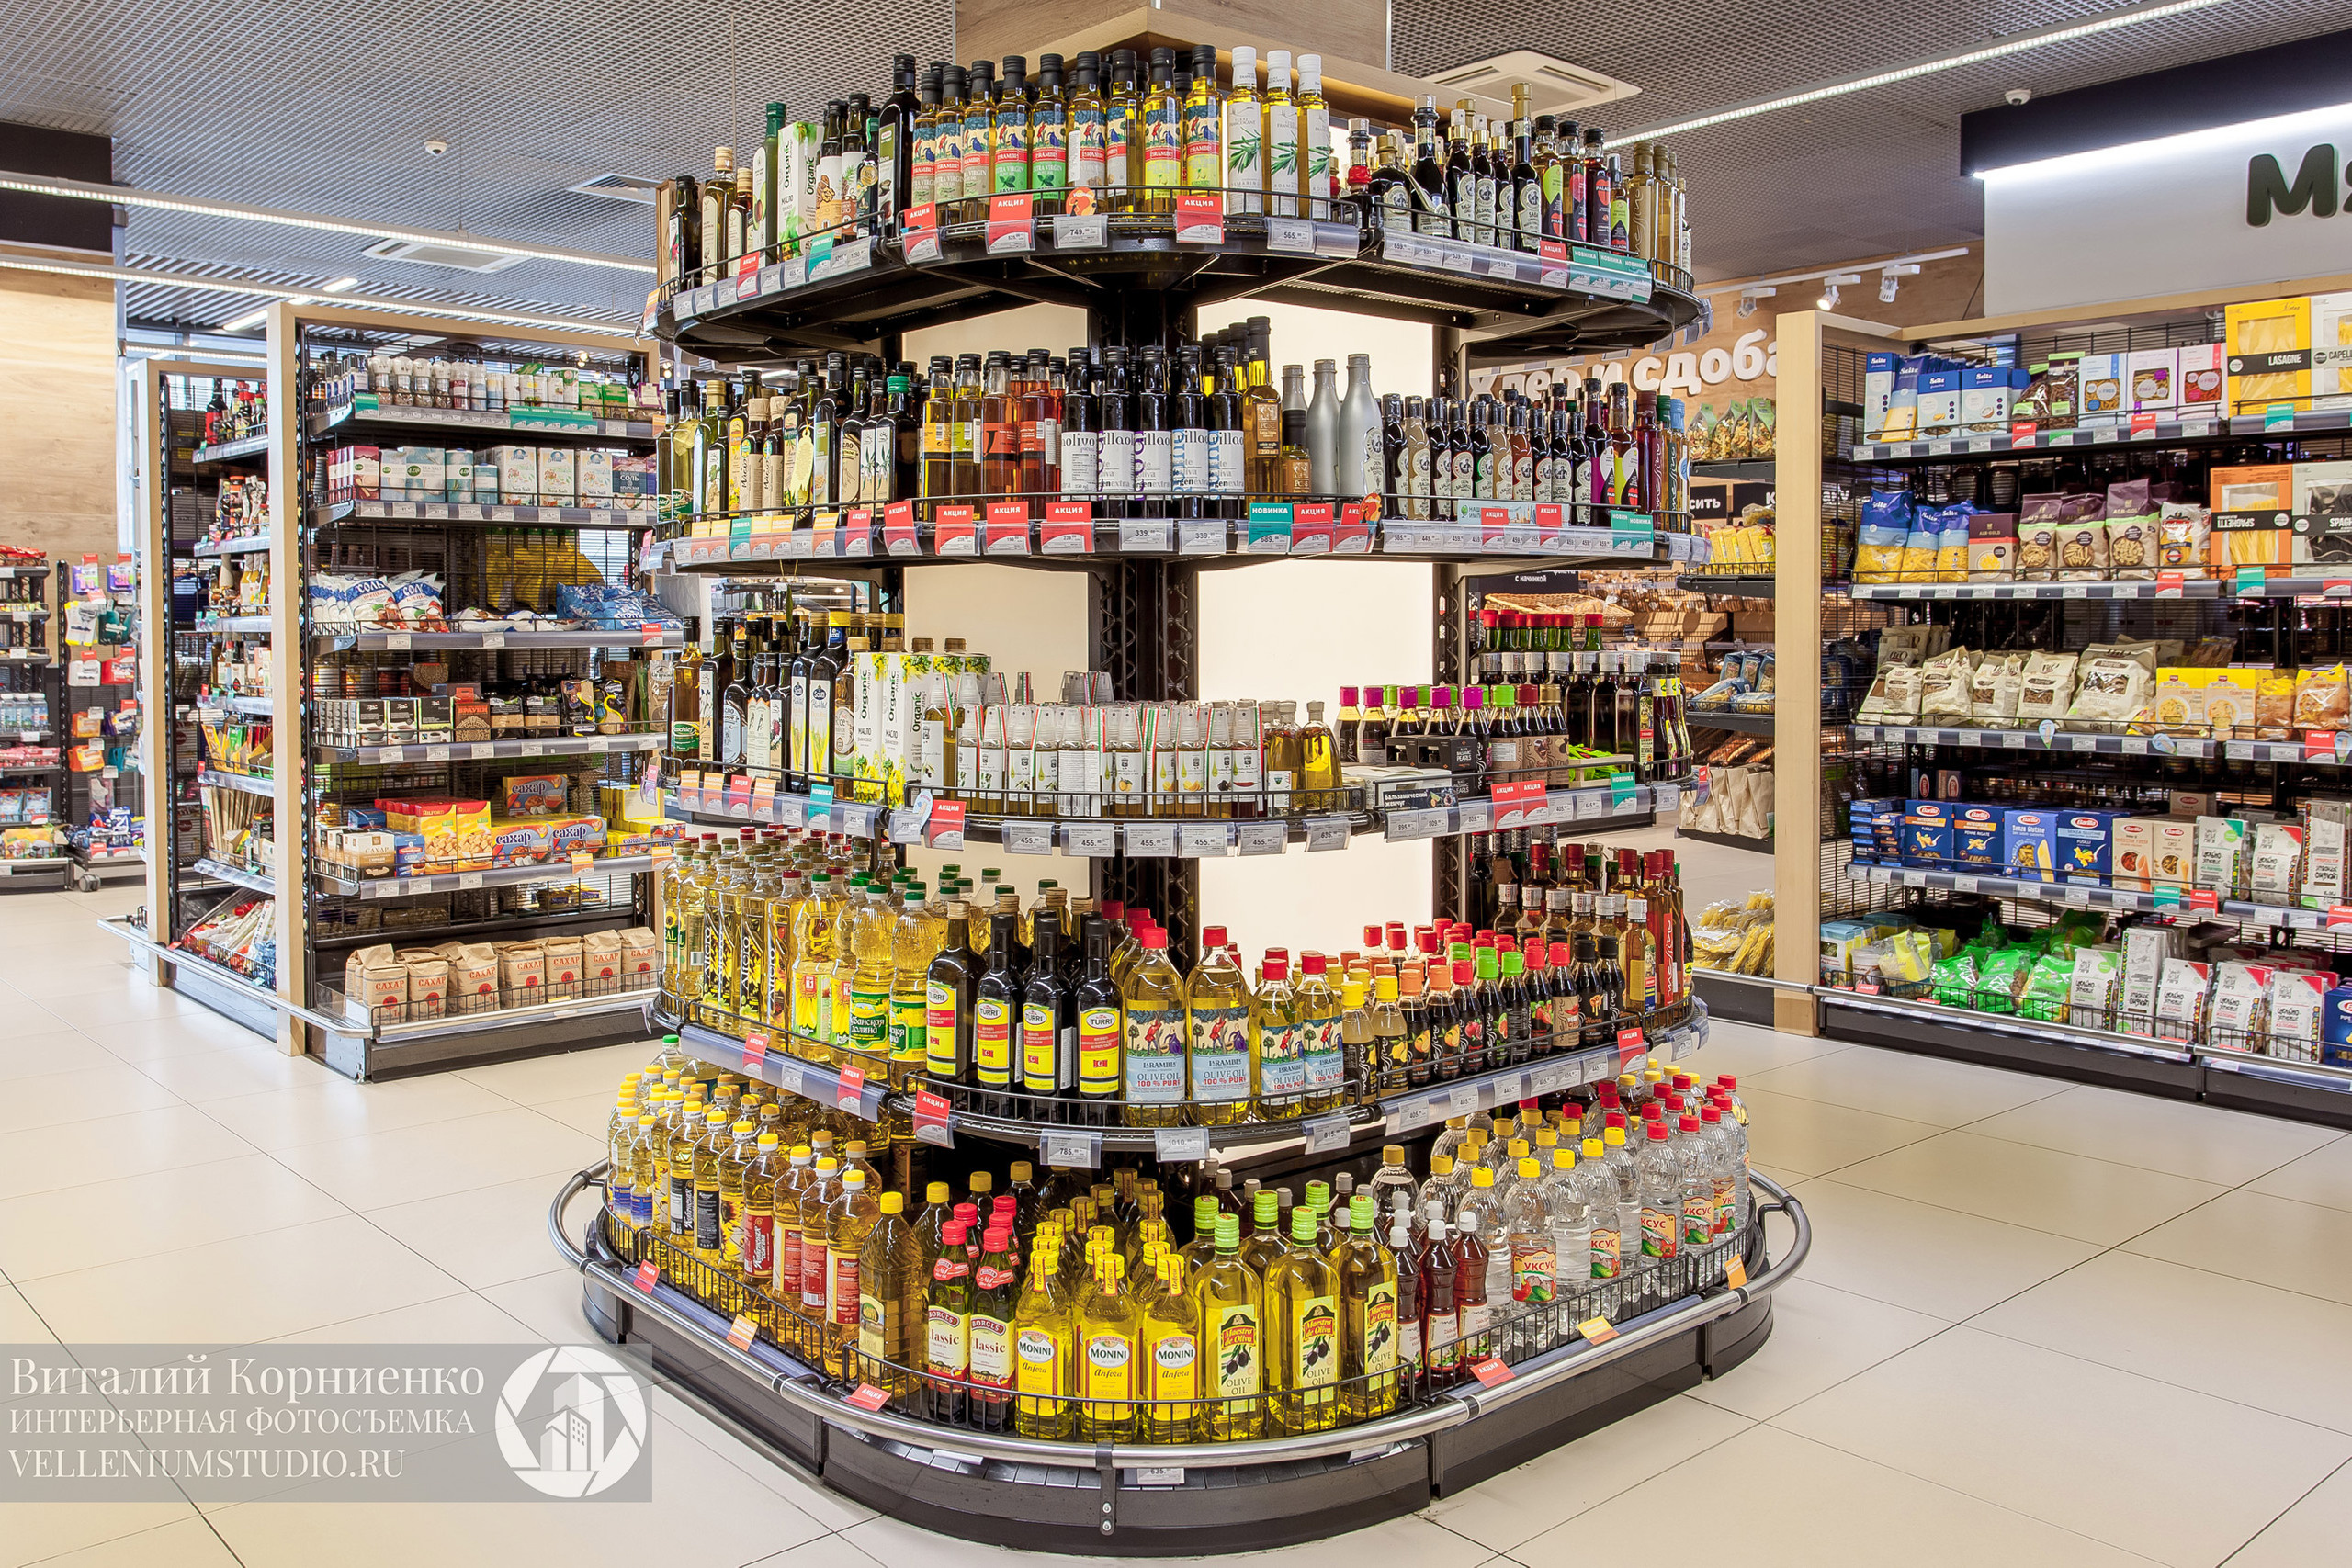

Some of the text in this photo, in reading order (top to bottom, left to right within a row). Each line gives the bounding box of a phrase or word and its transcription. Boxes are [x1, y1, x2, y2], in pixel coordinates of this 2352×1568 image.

[807, 156, 816, 196] Organic
[998, 199, 1024, 208] АКЦИЯ
[910, 208, 930, 219] АКЦИЯ
[742, 255, 756, 265] АКЦИЯ
[2268, 354, 2302, 367] LASAGNE
[888, 506, 907, 514] АКЦИЯ
[1055, 506, 1083, 514] АКЦИЯ
[2218, 517, 2255, 527] SPAGHETTI
[356, 580, 384, 592] СОЛЬ
[888, 671, 897, 722] Organic
[912, 691, 922, 732] Organic
[886, 730, 899, 739] МАСЛО
[512, 784, 547, 795] сахар
[1385, 792, 1428, 801] Бальзамический
[1385, 800, 1406, 808] жемчуг
[1920, 807, 1939, 816] Barilla
[2075, 819, 2098, 828] Barilla
[495, 832, 531, 846] сахар
[553, 827, 587, 841] сахар
[365, 846, 390, 854] САХАР
[593, 951, 619, 963] САХАР
[631, 947, 656, 958] САХАР
[517, 961, 544, 972] САХАР
[553, 956, 581, 967] САХАР
[469, 966, 497, 979] САХАР
[375, 980, 405, 991] САХАР
[418, 976, 447, 987] САХАР
[980, 1009, 998, 1017] TURRI
[1025, 1013, 1043, 1021] TURRI
[1091, 1018, 1113, 1026] TURRI
[1622, 1032, 1638, 1040] АКЦИЯ
[844, 1068, 860, 1078] АКЦИЯ
[1167, 1072, 1181, 1080] OIL
[1232, 1069, 1246, 1077] OIL
[1315, 1068, 1336, 1077] OLIVE
[1274, 1076, 1295, 1085] OLIVE
[922, 1096, 944, 1109] АКЦИЯ
[1524, 1258, 1555, 1272] УКСУС
[1369, 1303, 1392, 1314] Maestro
[1378, 1311, 1392, 1320] Oliva
[972, 1319, 1001, 1332] BORGES
[1306, 1318, 1332, 1328] Maestro
[1224, 1328, 1252, 1337] Maestro
[1315, 1325, 1331, 1335] Oliva
[1234, 1335, 1252, 1343] Oliva
[1019, 1341, 1052, 1356] MONINI
[1091, 1348, 1127, 1359] MONINI
[1158, 1348, 1193, 1360] MONINI
[1371, 1351, 1392, 1364] OLIVE
[1022, 1362, 1047, 1374] Anfora
[1375, 1361, 1387, 1371] OIL
[1478, 1362, 1498, 1373] АКЦИЯ
[1094, 1368, 1123, 1379] Anfora
[1162, 1369, 1190, 1379] Anfora
[1307, 1367, 1330, 1379] OLIVE
[1227, 1377, 1252, 1388] OLIVE
[1312, 1377, 1327, 1386] OIL
[862, 1388, 882, 1401] АКЦИЯ
[1231, 1386, 1247, 1395] OIL
